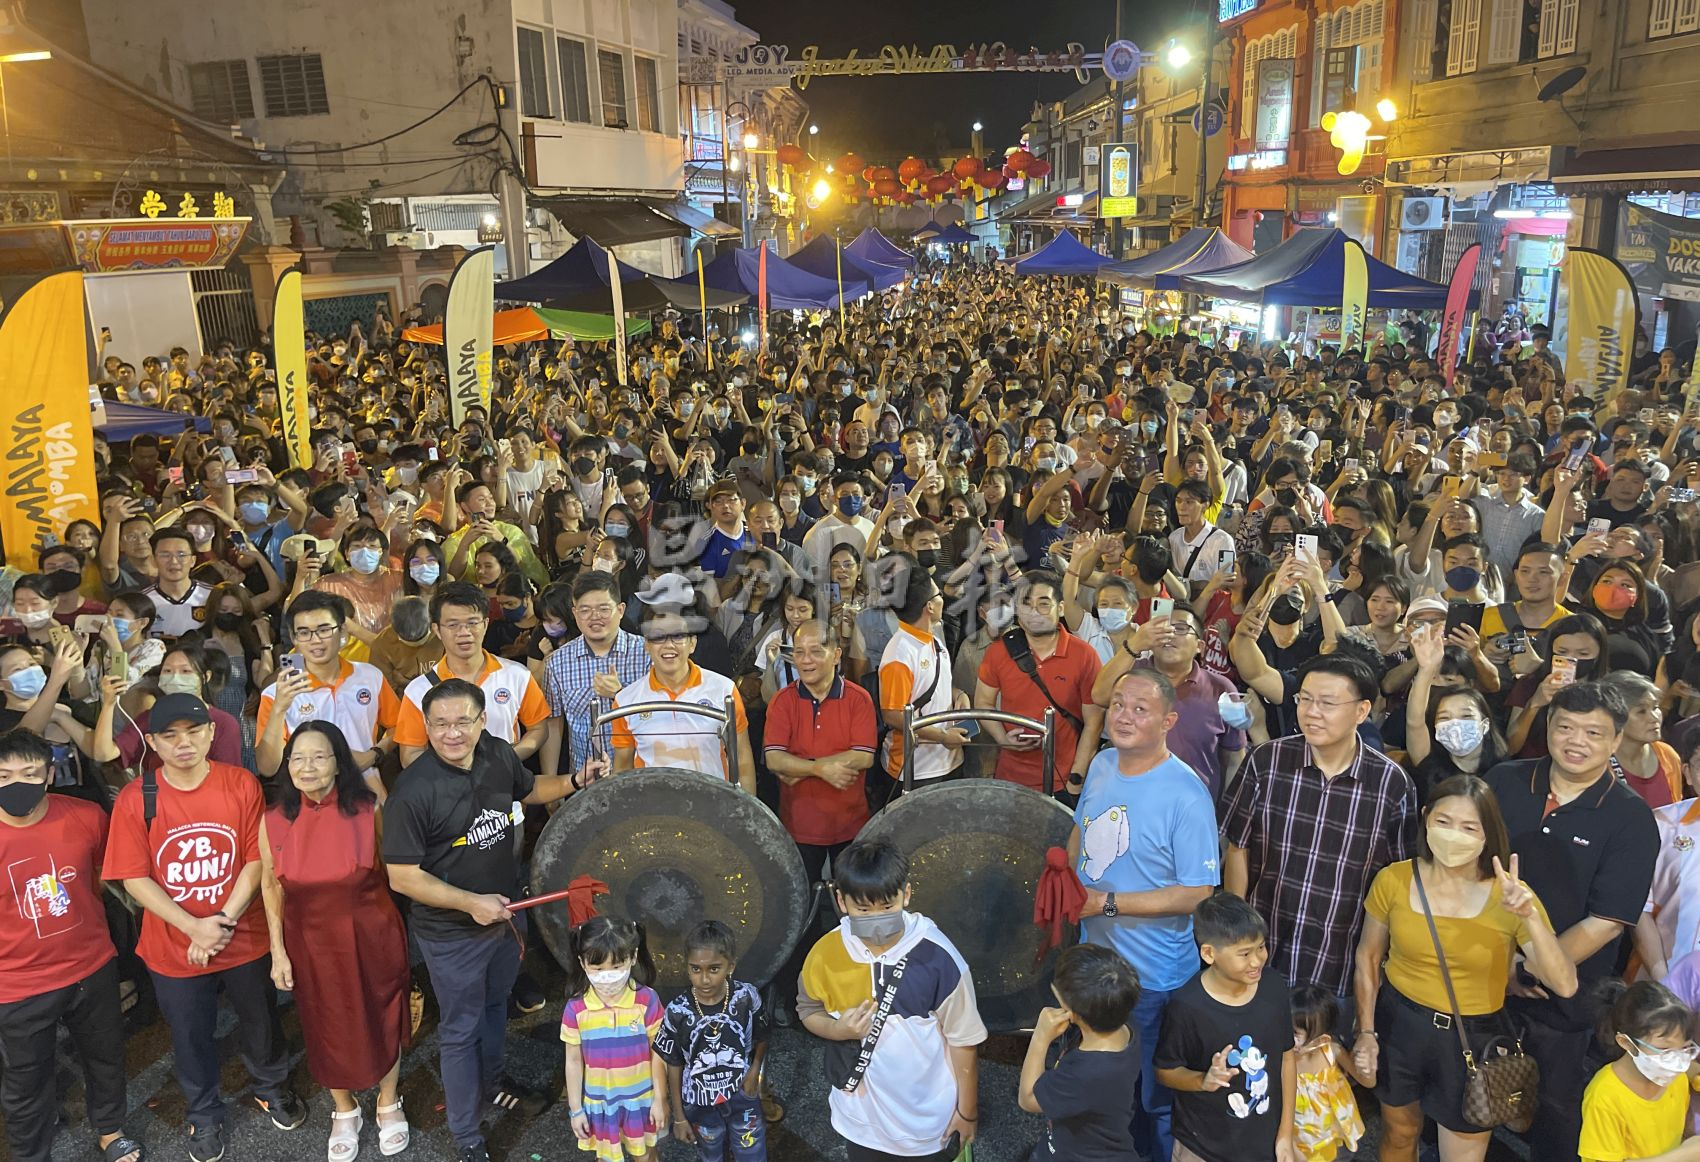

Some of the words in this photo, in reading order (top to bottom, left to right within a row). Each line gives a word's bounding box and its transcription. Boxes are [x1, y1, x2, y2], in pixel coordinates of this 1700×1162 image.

[736, 45, 788, 65] JOY
[467, 813, 510, 846] HIMALAYA
[479, 831, 506, 851] Sports
[177, 836, 218, 861] YB.
[167, 852, 231, 884] RUN!
[867, 984, 898, 1045] SUPREME
[725, 1070, 734, 1078] BE
